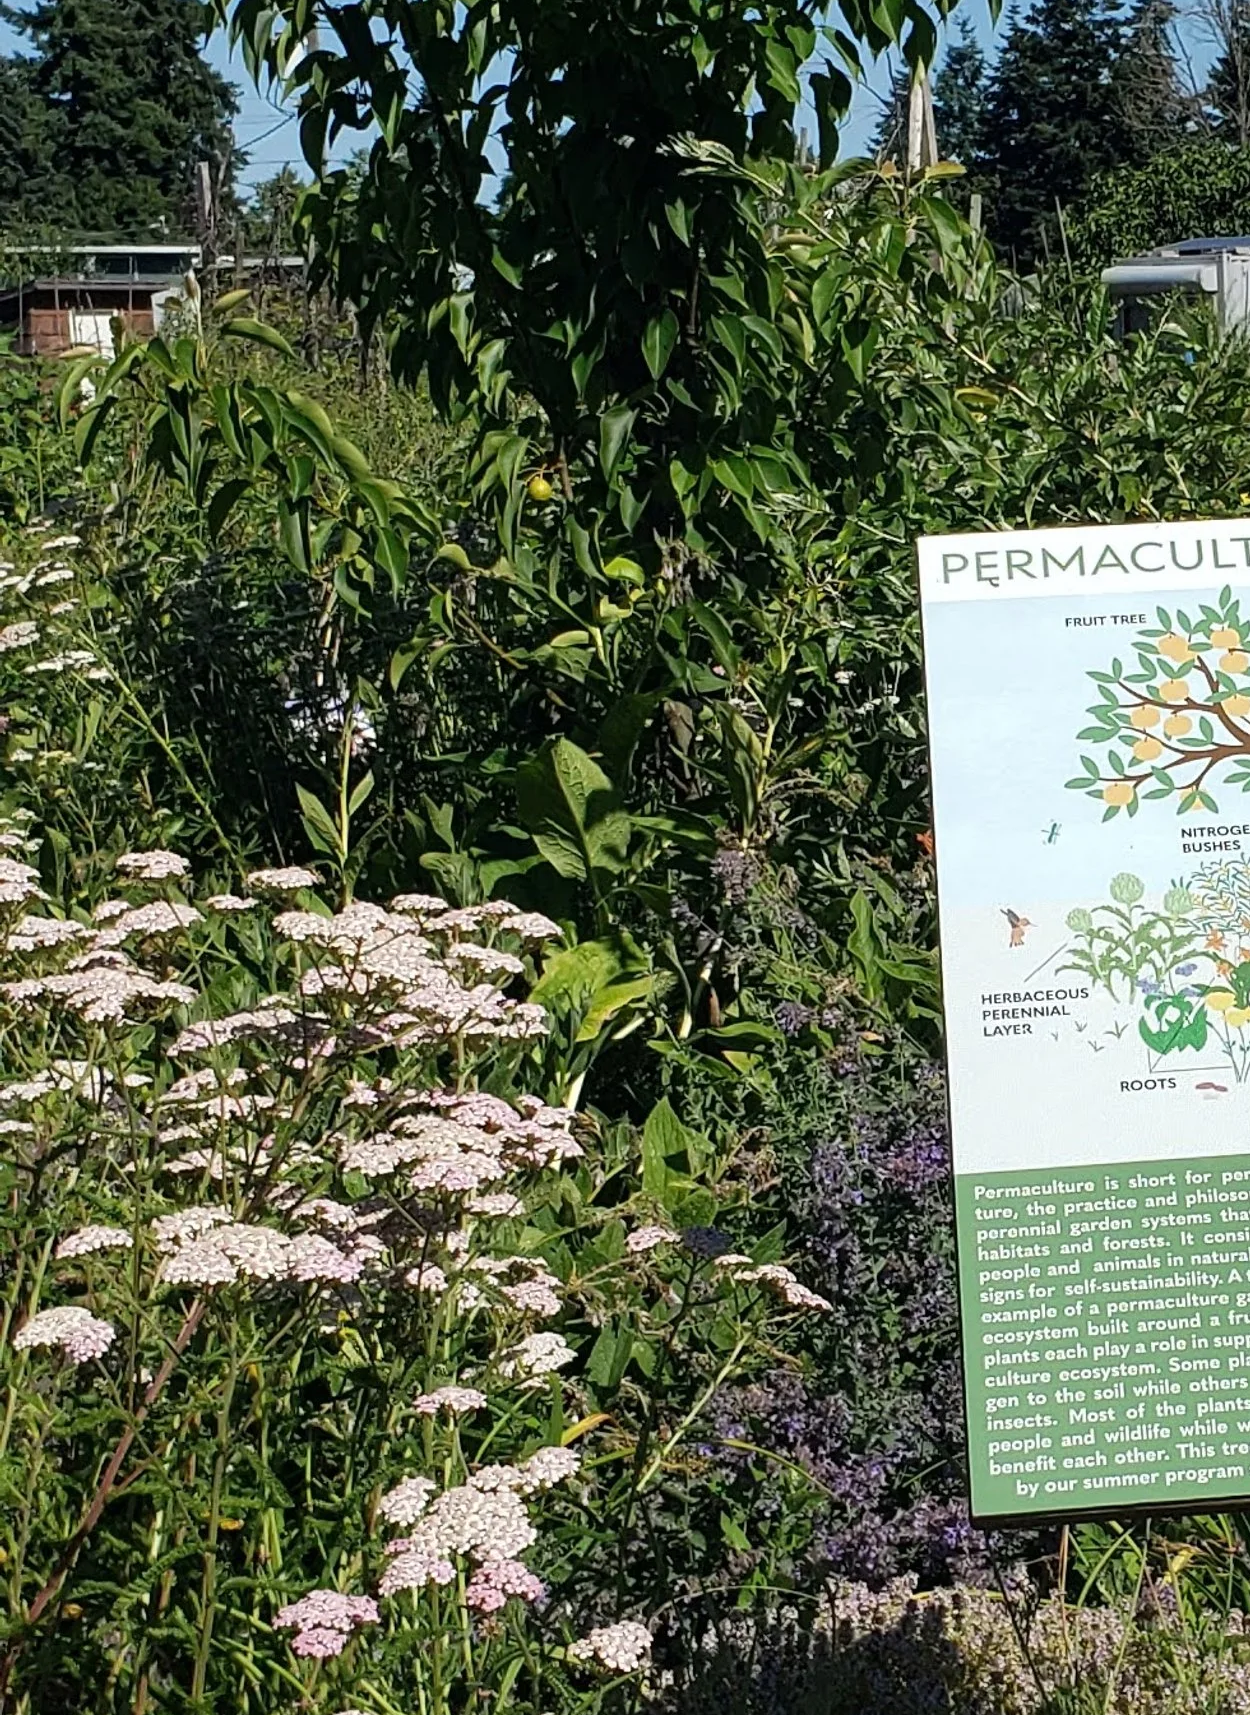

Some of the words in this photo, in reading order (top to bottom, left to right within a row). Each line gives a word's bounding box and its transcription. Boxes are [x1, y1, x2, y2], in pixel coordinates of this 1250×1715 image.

[1065, 615, 1107, 628] FRUIT
[1111, 613, 1147, 626] TREE
[1182, 840, 1242, 853] BUSHES
[981, 988, 1090, 1005] HERBACEOUS
[982, 1005, 1071, 1021] PERENNIAL
[983, 1023, 1033, 1037] LAYER
[1120, 1078, 1177, 1092] ROOTS
[974, 1179, 1095, 1200] Permaculture
[1104, 1176, 1119, 1190] is
[1128, 1173, 1176, 1189] short
[1184, 1170, 1212, 1185] for
[974, 1208, 1018, 1221] ture,
[1025, 1200, 1056, 1216] the
[1063, 1195, 1137, 1217] practice
[1145, 1191, 1178, 1208] and
[977, 1219, 1061, 1244] perennial
[1069, 1216, 1132, 1237] garden
[1141, 1213, 1212, 1231] systems
[977, 1244, 1051, 1261] habitats
[1059, 1237, 1093, 1255] and
[1103, 1234, 1171, 1251] forests.
[1180, 1231, 1194, 1246] It
[982, 1326, 1079, 1345] ecosystem
[1087, 1318, 1129, 1336] built
[1137, 1312, 1201, 1333] around
[1210, 1316, 1221, 1327] a
[984, 1370, 1051, 1388] culture
[1058, 1362, 1161, 1382] ecosystem.
[1168, 1357, 1221, 1373] Some
[988, 1433, 1052, 1457] people
[1061, 1428, 1096, 1447] and
[1104, 1423, 1171, 1443] wildlife
[1179, 1418, 1228, 1437] while
[989, 1455, 1057, 1475] benefit
[1062, 1450, 1107, 1469] each
[1114, 1446, 1170, 1465] other.
[1175, 1441, 1216, 1459] This
[1016, 1479, 1039, 1498] by
[1044, 1479, 1078, 1493] our
[1083, 1472, 1160, 1490] summer
[1165, 1465, 1244, 1486] program
